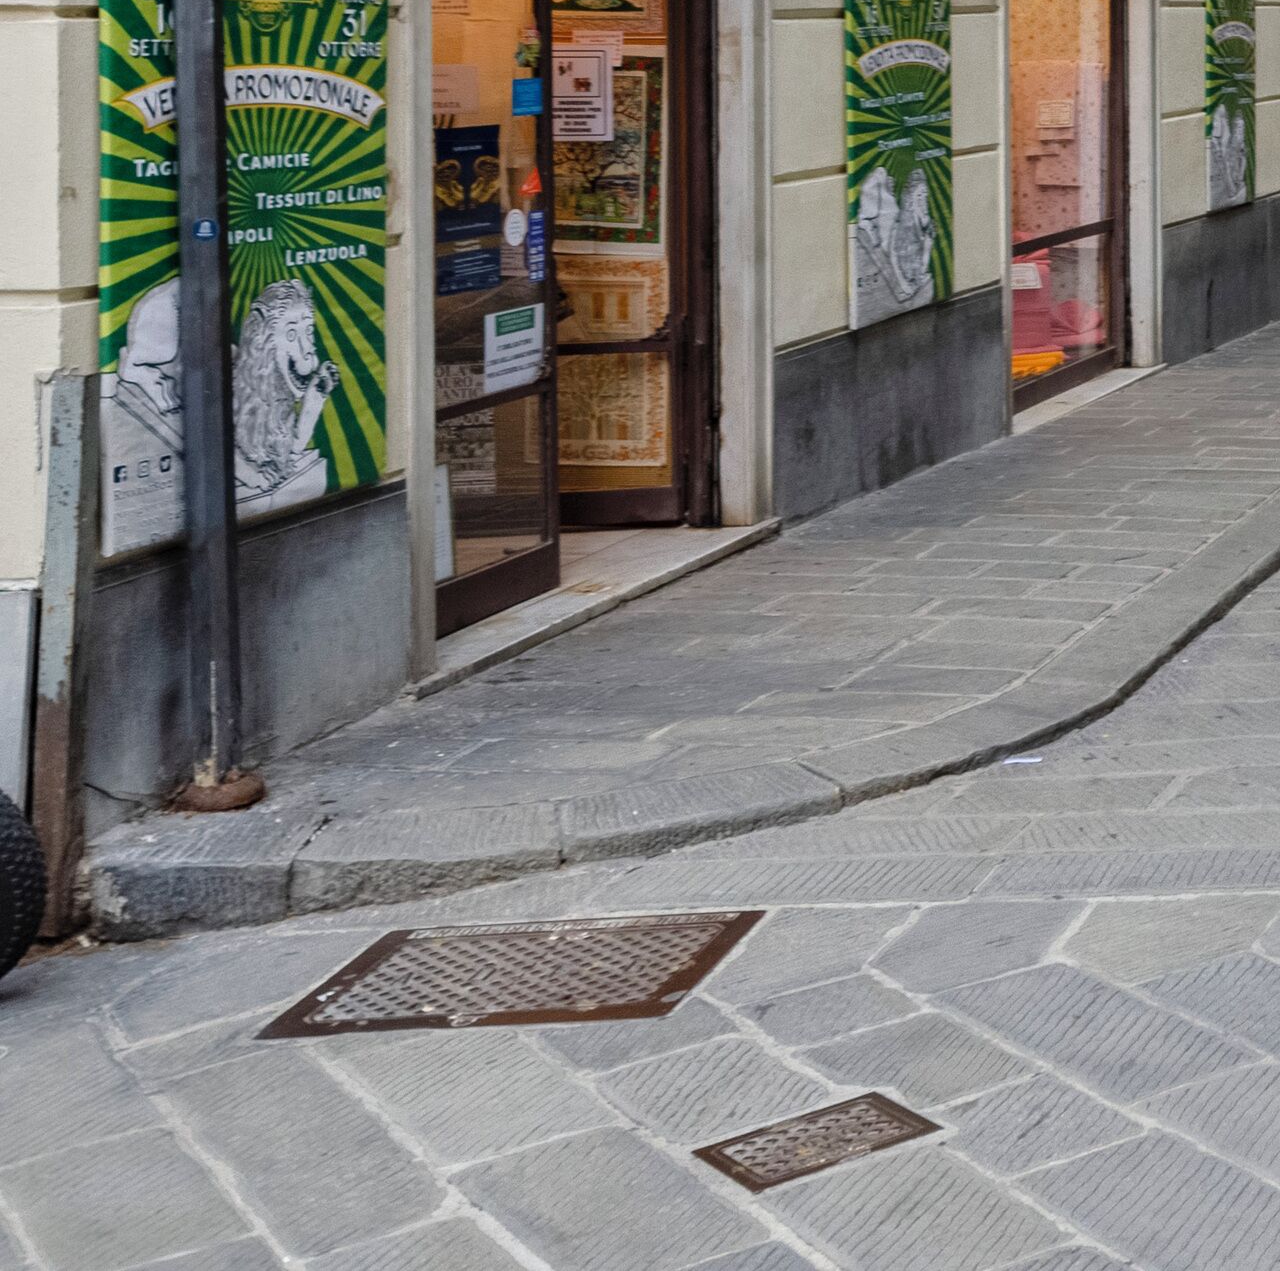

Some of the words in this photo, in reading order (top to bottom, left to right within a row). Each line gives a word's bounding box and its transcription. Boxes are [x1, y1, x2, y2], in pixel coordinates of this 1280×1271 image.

[342, 8, 368, 37] 31
[317, 40, 382, 58] OTTOBRE
[234, 73, 373, 119] PROMOZIONALE
[236, 152, 310, 171] CAMICIE
[255, 191, 321, 210] TESSUTI
[325, 189, 344, 203] DI
[347, 185, 383, 202] LINO
[285, 243, 368, 267] LENZUOLA
